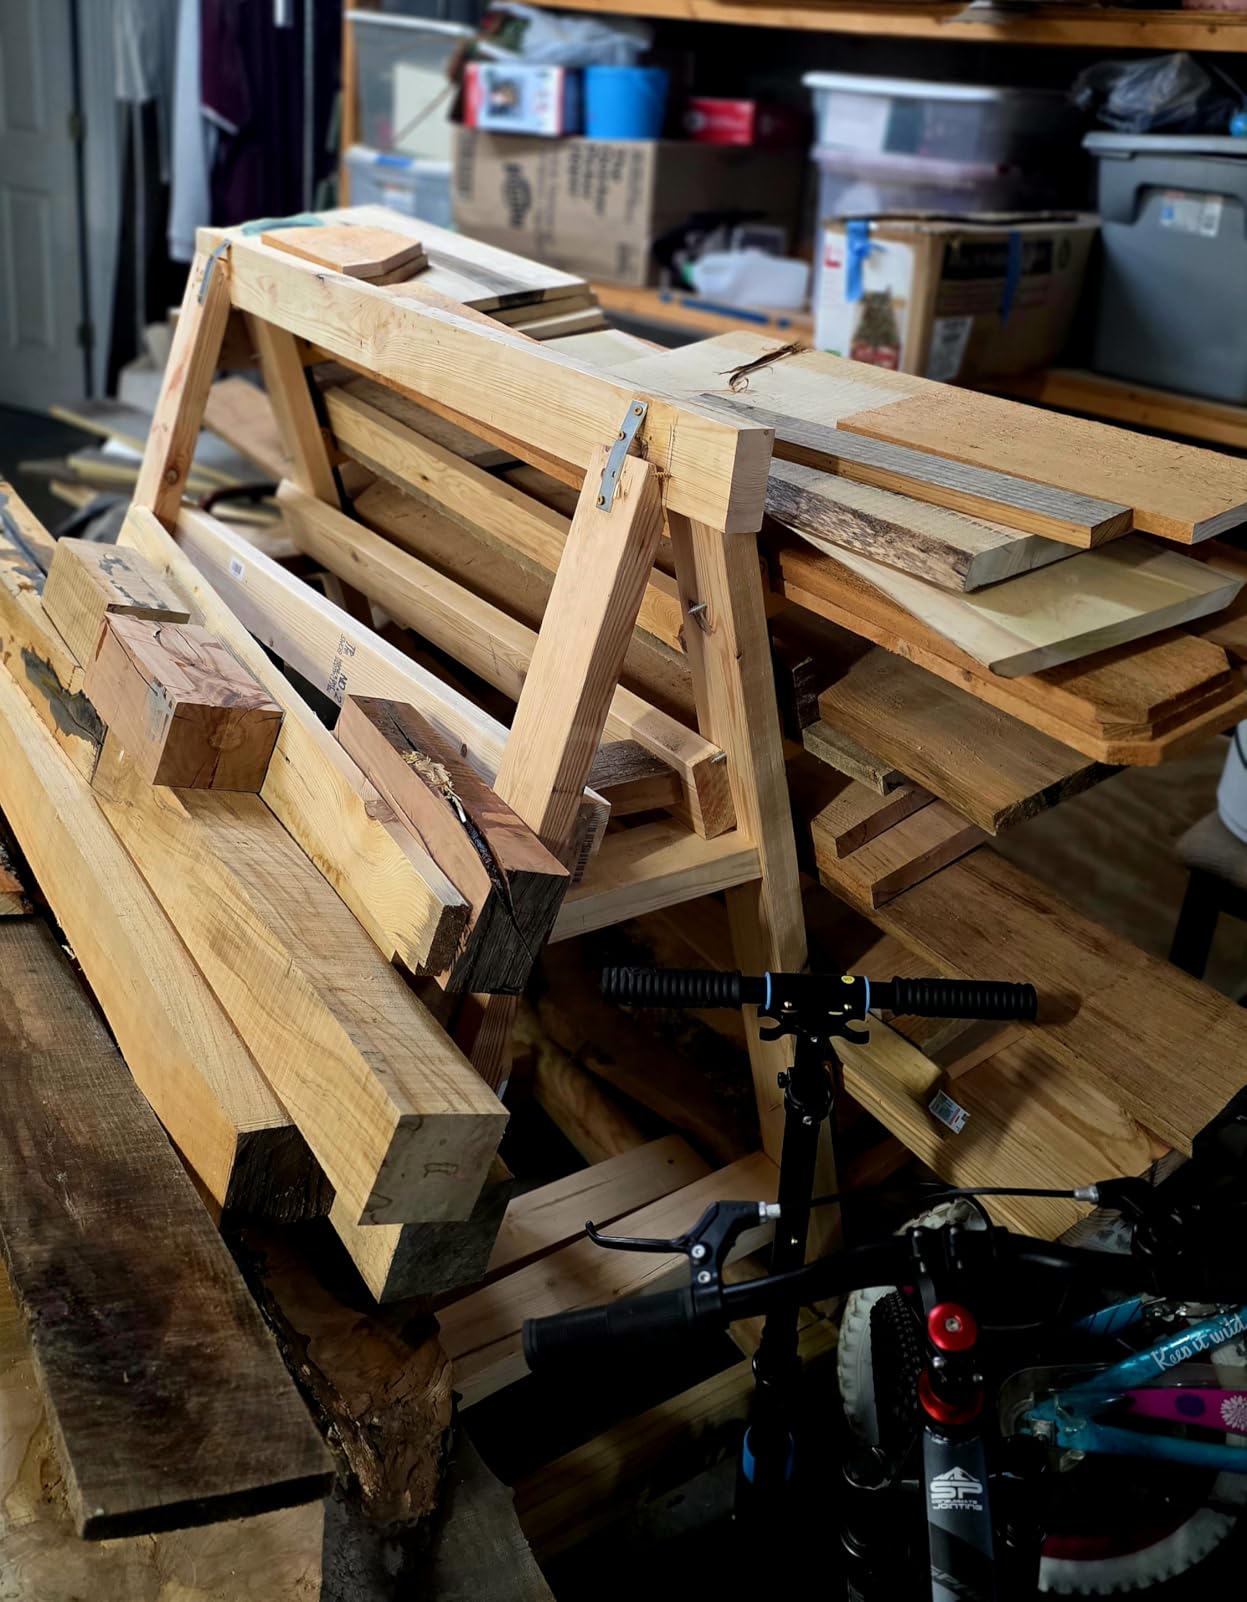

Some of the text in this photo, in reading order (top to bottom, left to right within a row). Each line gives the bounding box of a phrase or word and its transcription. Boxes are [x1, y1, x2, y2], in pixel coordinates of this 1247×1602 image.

[1151, 1346, 1192, 1371] Keep
[1192, 1333, 1210, 1352] it
[930, 1481, 983, 1499] SP
